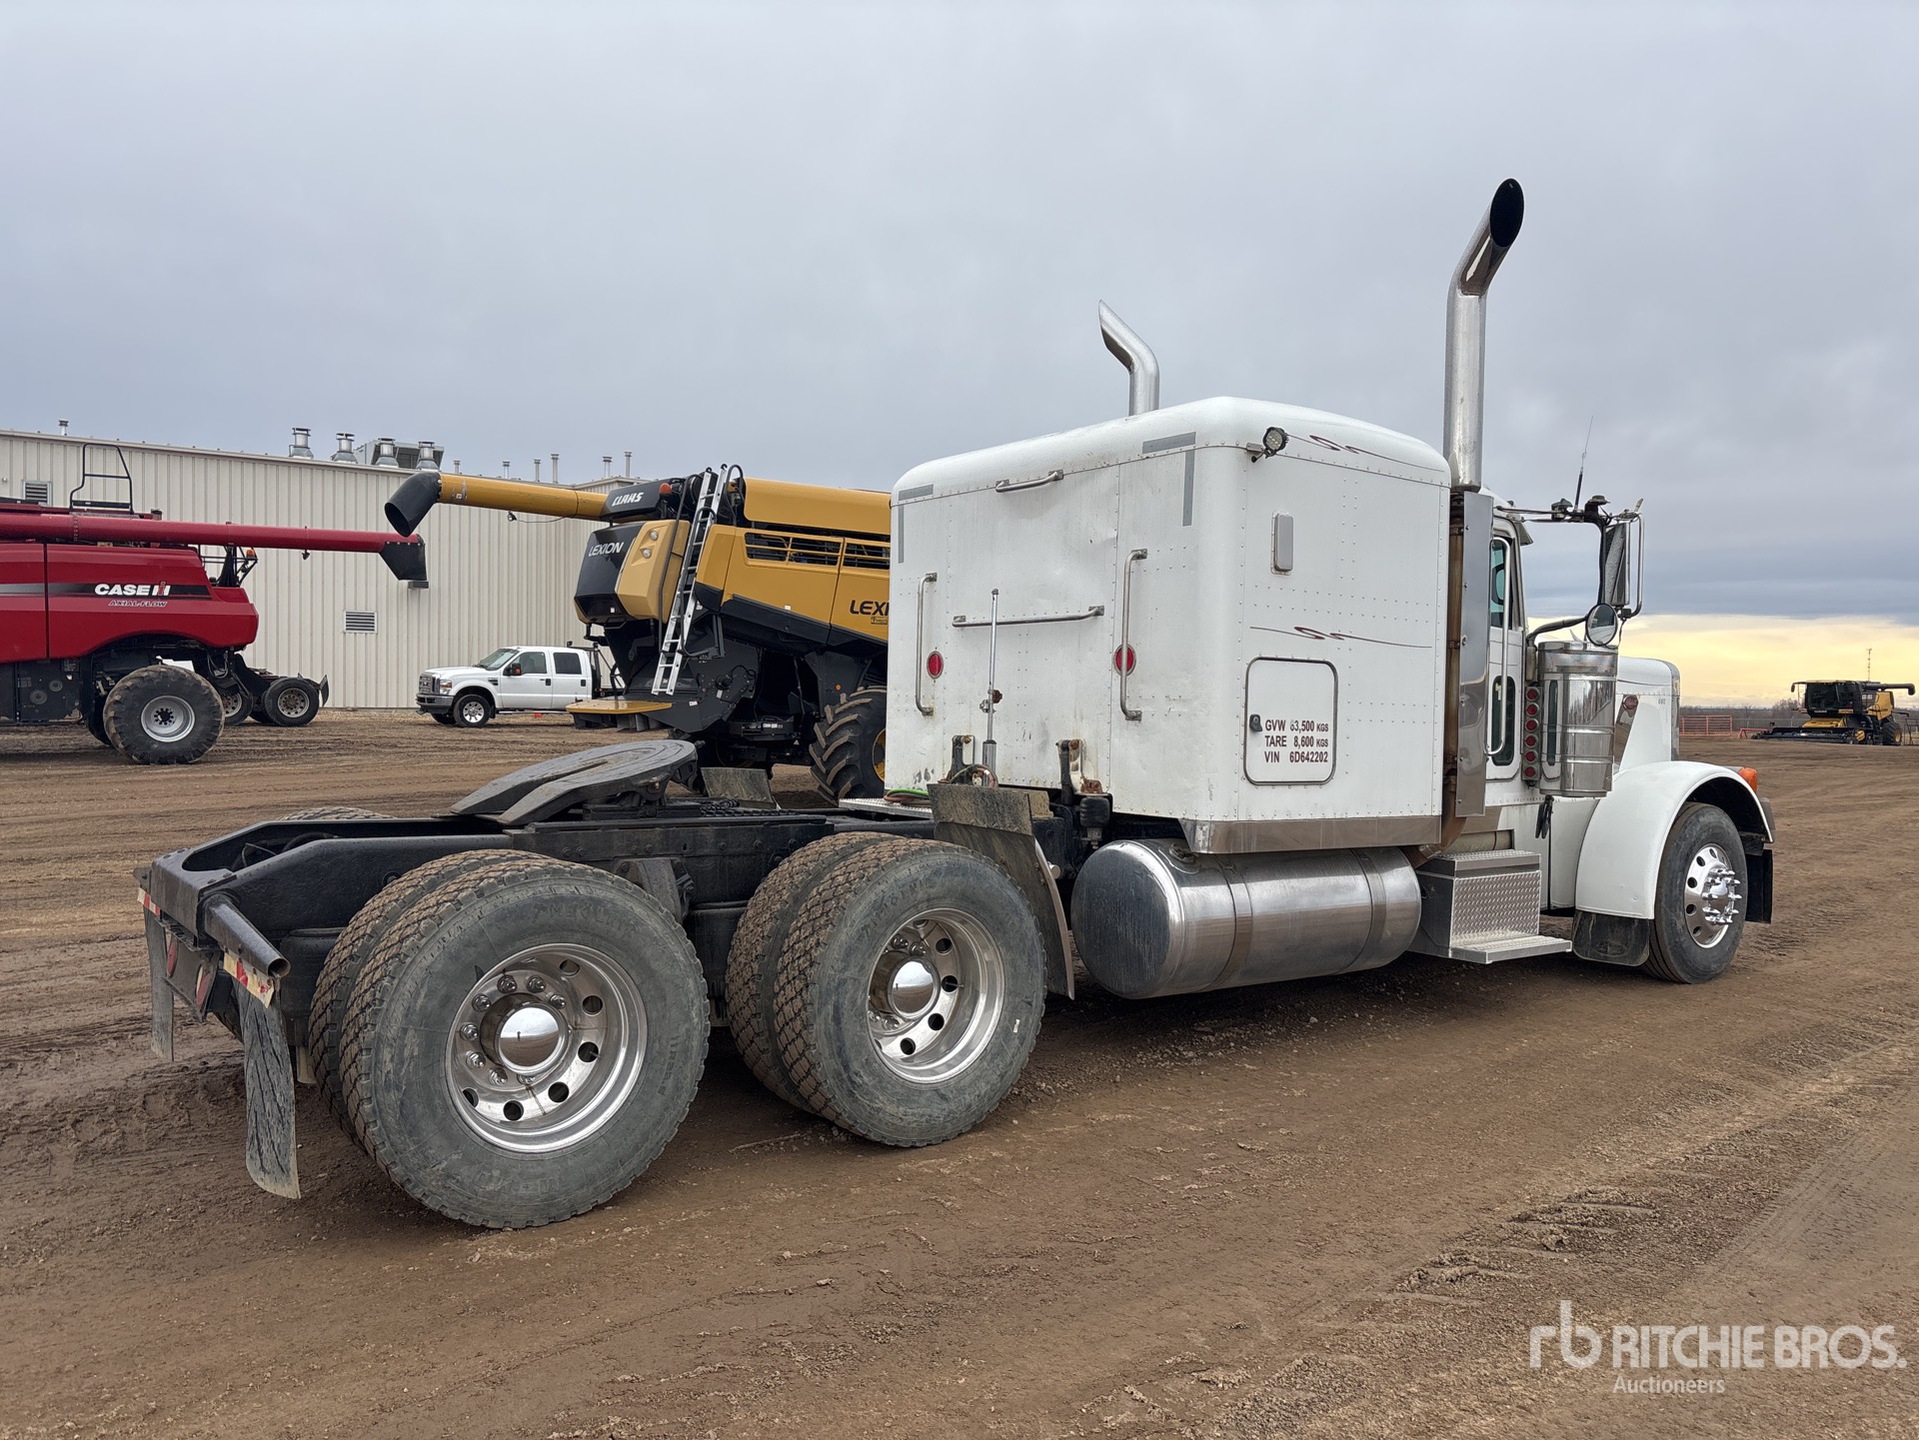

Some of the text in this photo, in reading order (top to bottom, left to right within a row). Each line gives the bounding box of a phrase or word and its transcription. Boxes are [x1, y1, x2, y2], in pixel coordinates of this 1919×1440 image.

[611, 492, 645, 507] CLAAS
[588, 541, 625, 557] LEXION
[94, 583, 151, 596] CASE
[1265, 719, 1287, 732] GVW
[1316, 723, 1329, 732] KGS
[1264, 735, 1329, 750] TARE 8,600 KGS
[1264, 751, 1329, 763] VIN 6D642202
